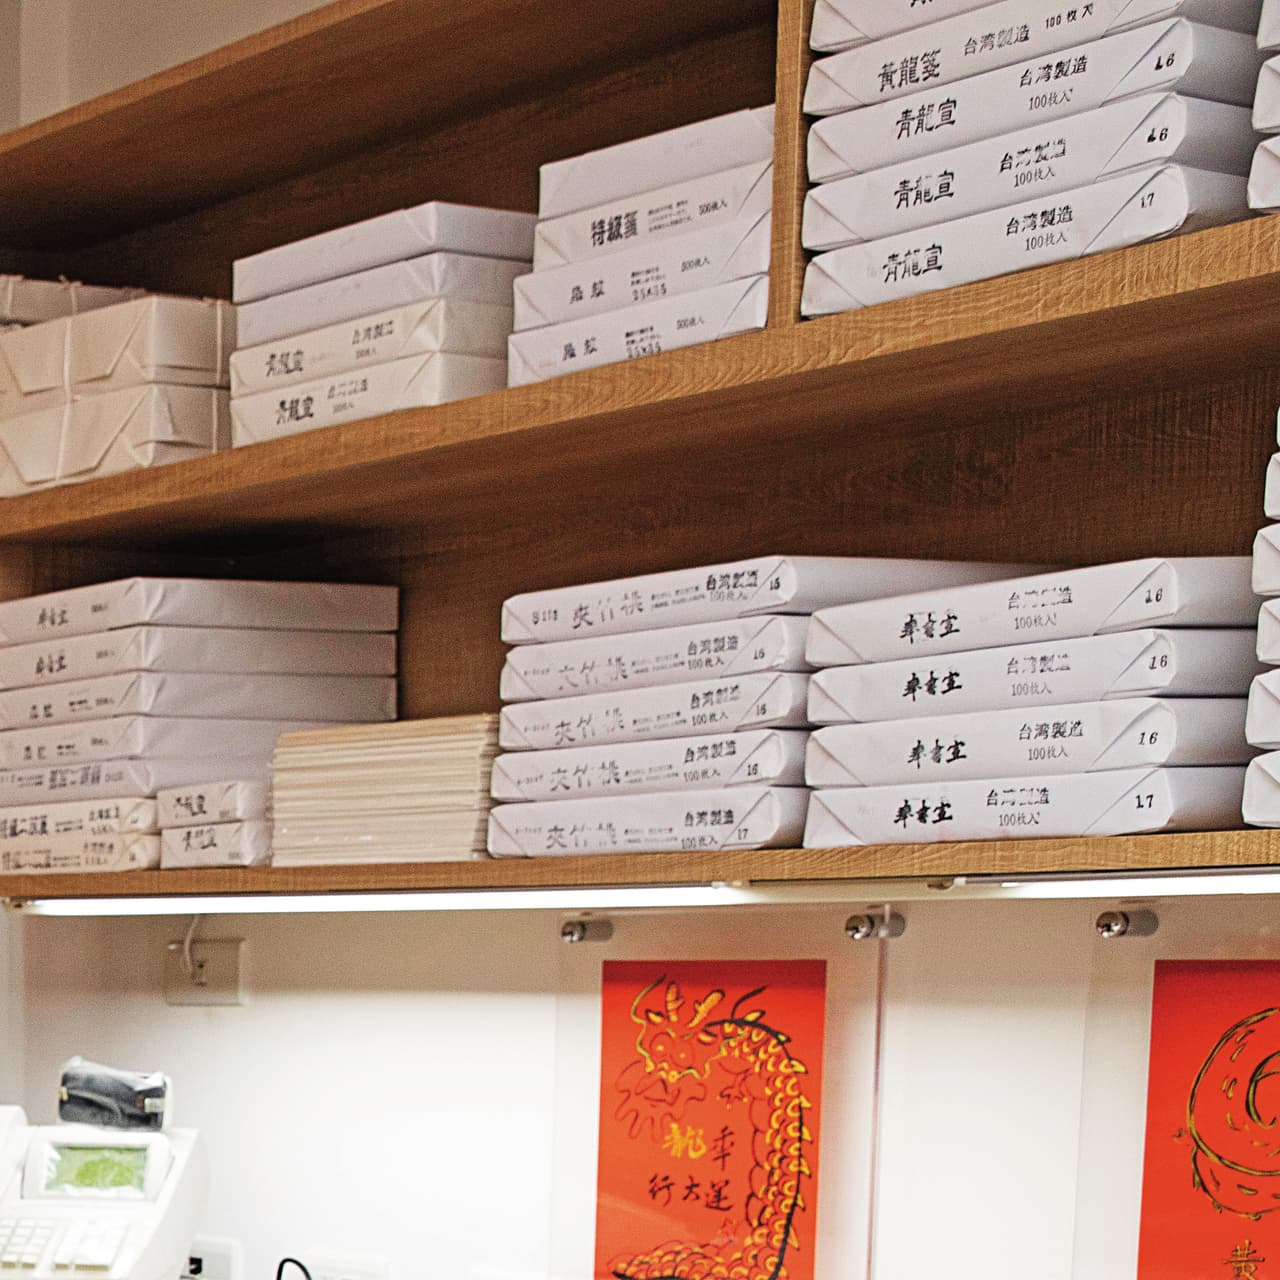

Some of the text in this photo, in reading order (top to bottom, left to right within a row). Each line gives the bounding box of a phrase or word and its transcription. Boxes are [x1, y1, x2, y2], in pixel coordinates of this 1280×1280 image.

[895, 98, 957, 140] 青龍宣
[1144, 588, 1164, 604] 16
[1148, 654, 1168, 670] 16
[1138, 732, 1158, 746] 16
[1135, 795, 1154, 810] 17
